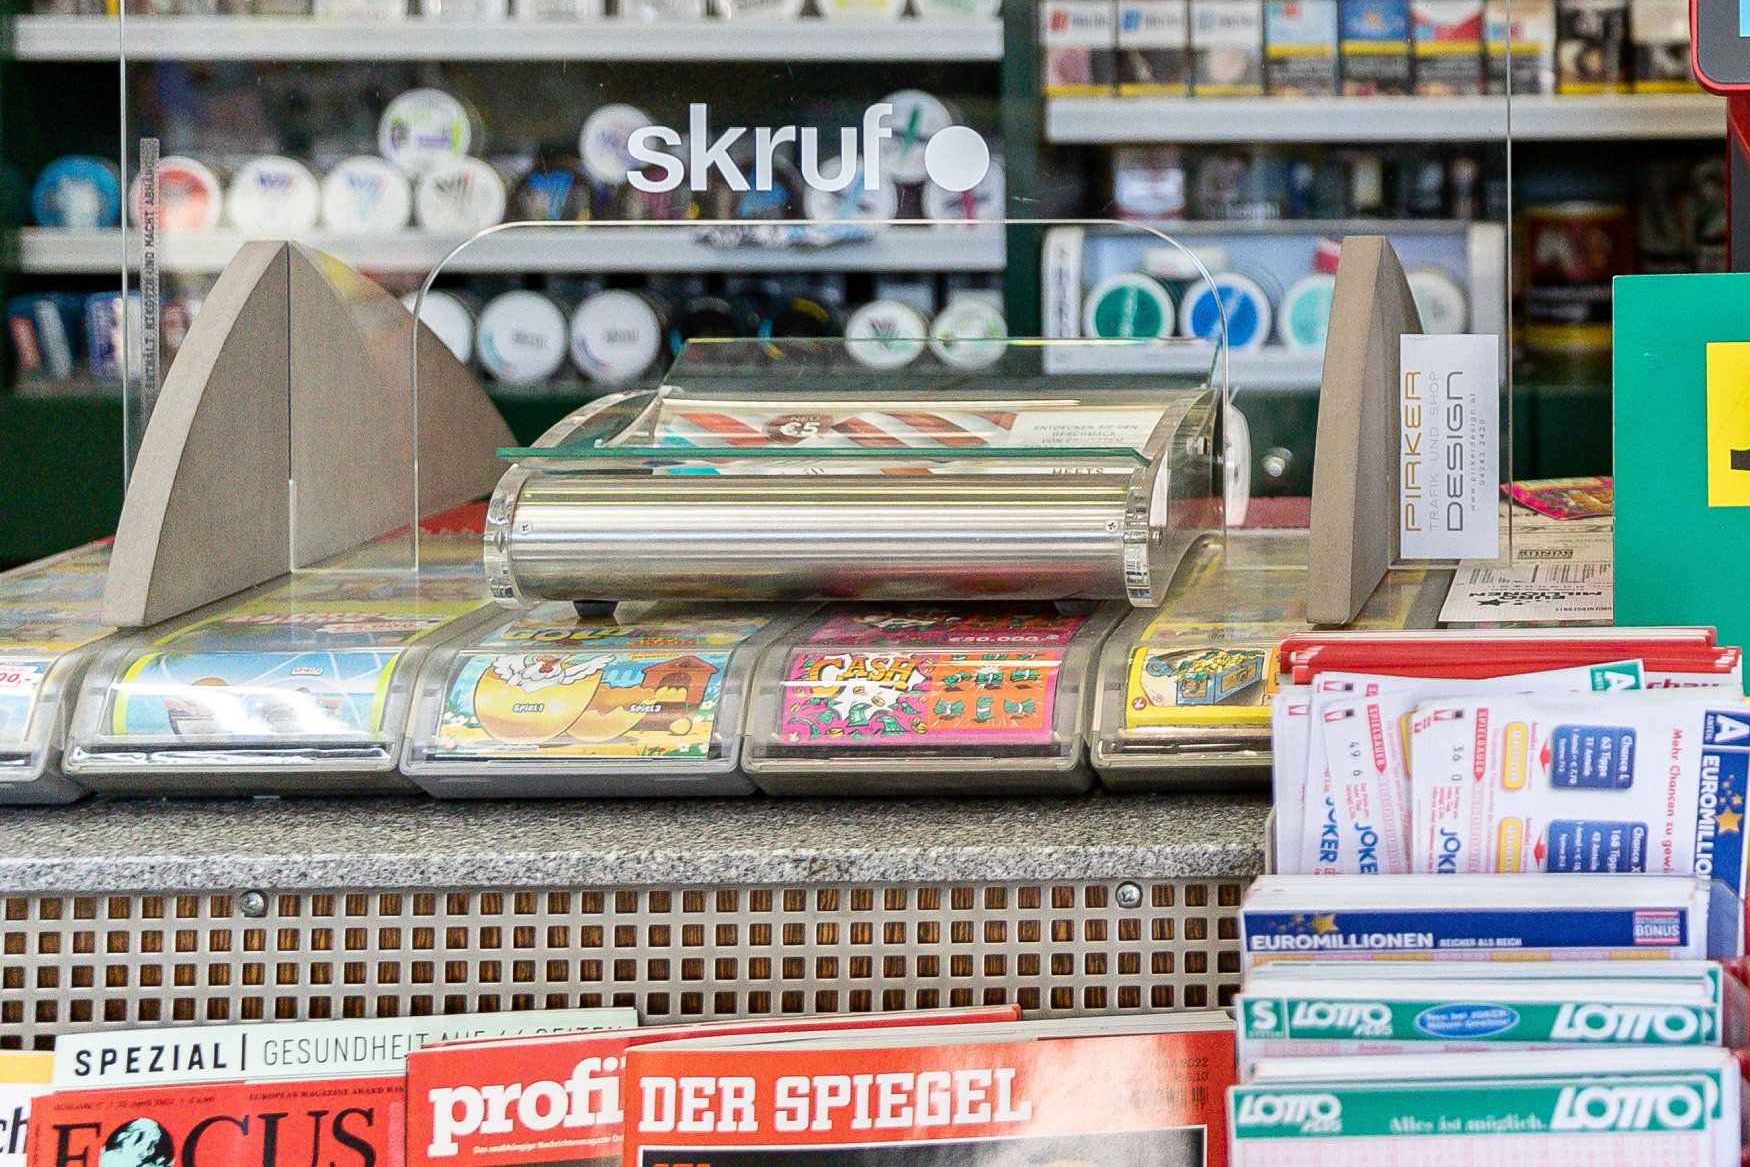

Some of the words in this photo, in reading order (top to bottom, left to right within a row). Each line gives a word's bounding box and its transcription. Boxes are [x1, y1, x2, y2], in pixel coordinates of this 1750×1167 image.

[625, 102, 894, 195] skruf
[1429, 370, 1440, 416] SHOP
[1405, 371, 1421, 532] PIRKER
[1429, 427, 1440, 462] UND
[1446, 371, 1464, 531] DESIGN
[1429, 473, 1440, 532] TRAFIK
[810, 654, 920, 697] CASH
[1714, 714, 1750, 744] A
[1251, 933, 1434, 951] EUROMILLIONEN
[1252, 1000, 1278, 1030] S
[1291, 1002, 1393, 1029] LOTTO
[1550, 1003, 1699, 1041] LOTTO
[75, 1042, 227, 1076] SPEZIAL
[264, 1033, 430, 1066] GESUNDHEIT
[427, 1057, 625, 1157] profi
[639, 1075, 758, 1132] DER
[775, 1068, 1032, 1131] SPIEGEL
[1237, 1094, 1342, 1125] LOTTO
[1550, 1085, 1702, 1130] LOTTO
